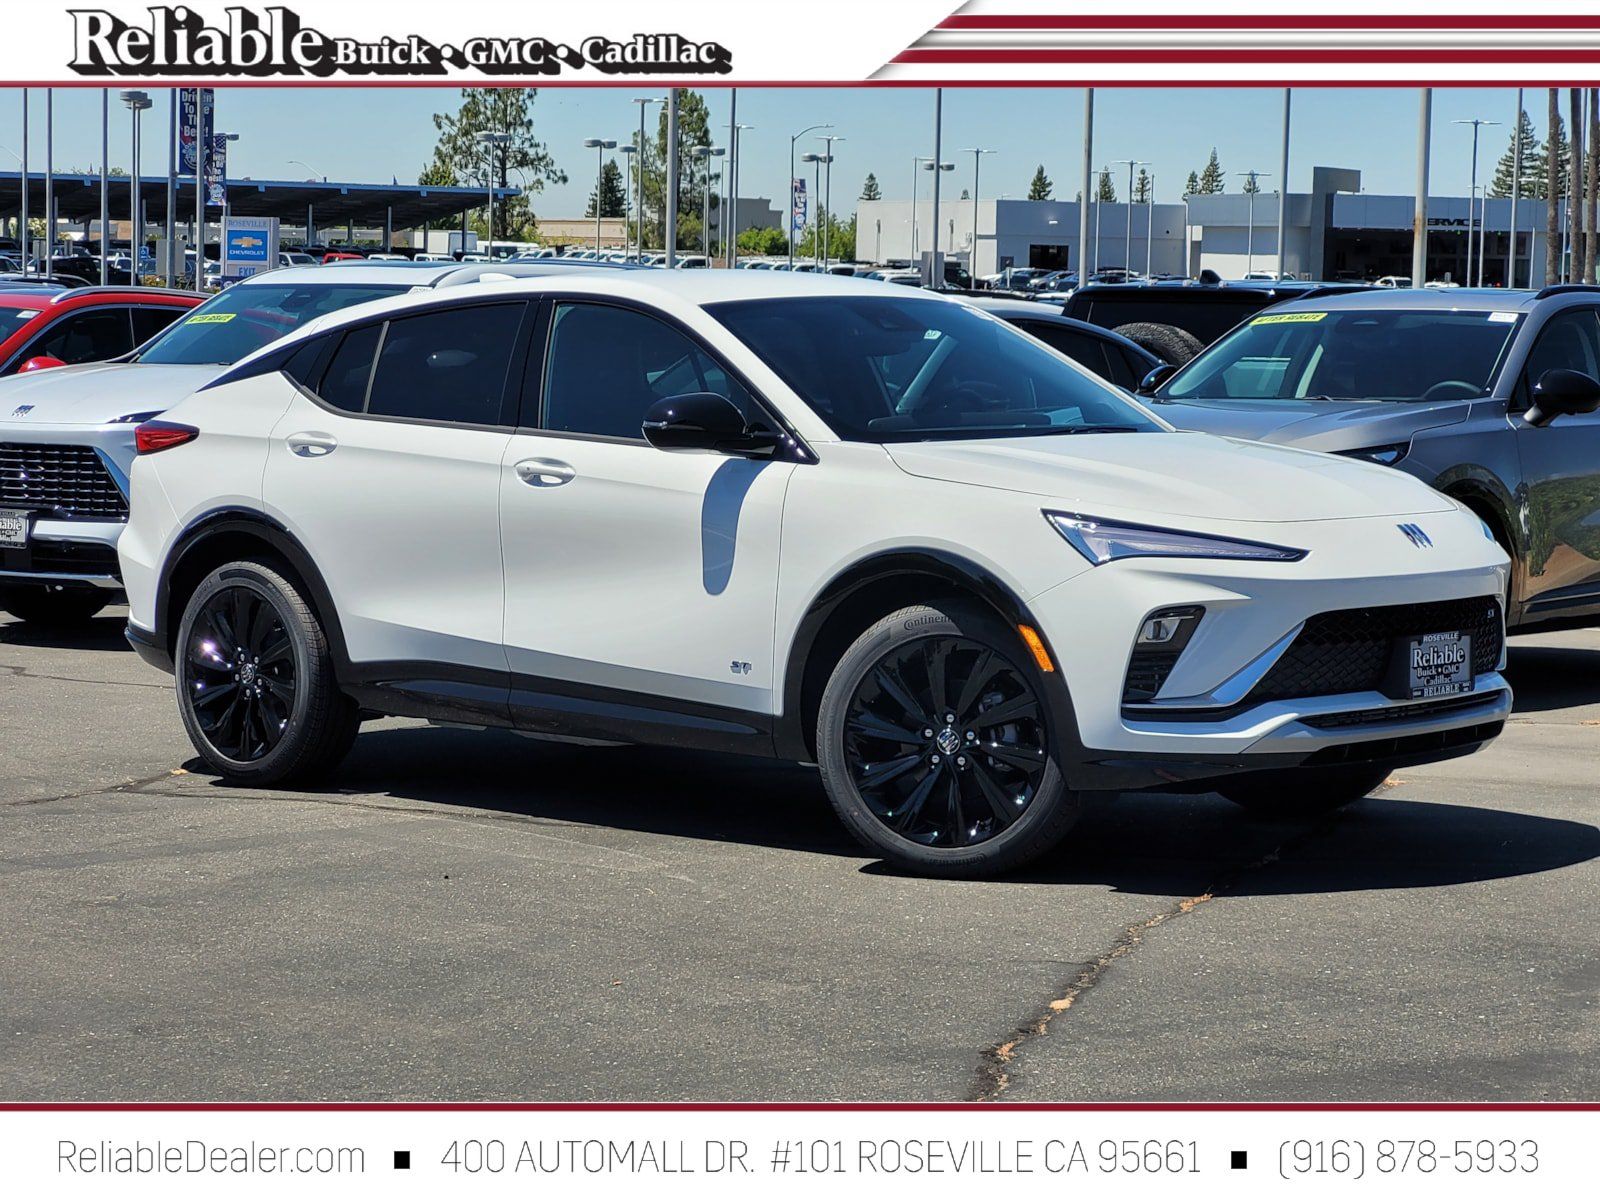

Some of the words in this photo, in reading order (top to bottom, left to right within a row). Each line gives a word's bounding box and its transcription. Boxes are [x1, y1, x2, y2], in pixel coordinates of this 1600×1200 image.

[184, 102, 195, 114] To
[183, 125, 209, 137] Be!
[228, 219, 269, 228] ROSEVILLE
[1413, 218, 1481, 226] ERVICE
[238, 266, 256, 277] EXIT
[1423, 632, 1460, 642] ROSEVILLE
[1413, 644, 1465, 668] Reliable
[1417, 666, 1437, 677] Buick
[1443, 665, 1459, 674] GMC
[1424, 675, 1452, 686] Cadillac
[1423, 684, 1460, 697] RELIABLE
